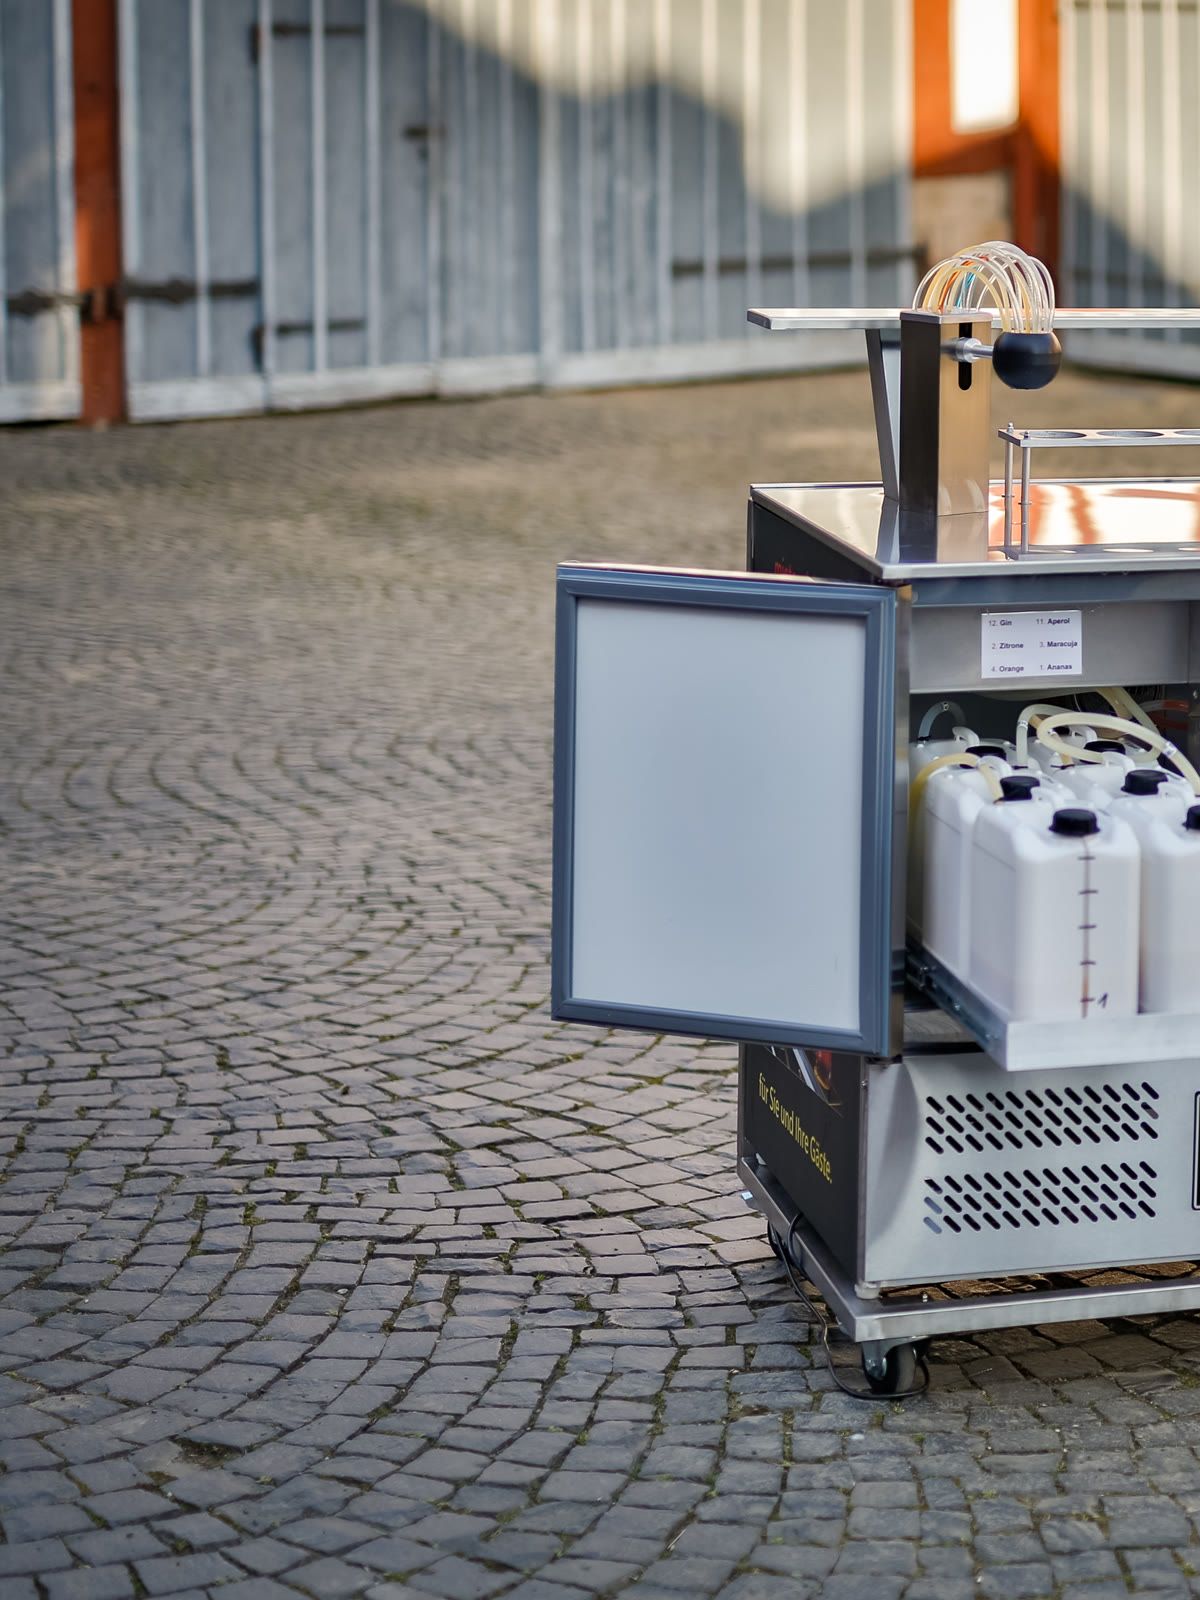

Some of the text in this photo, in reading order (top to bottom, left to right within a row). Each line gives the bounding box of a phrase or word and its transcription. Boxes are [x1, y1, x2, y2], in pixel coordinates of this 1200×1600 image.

[999, 665, 1024, 673] Orange
[1098, 993, 1108, 1008] 1
[758, 1072, 832, 1184] für Sie und Ihre Gäste.
